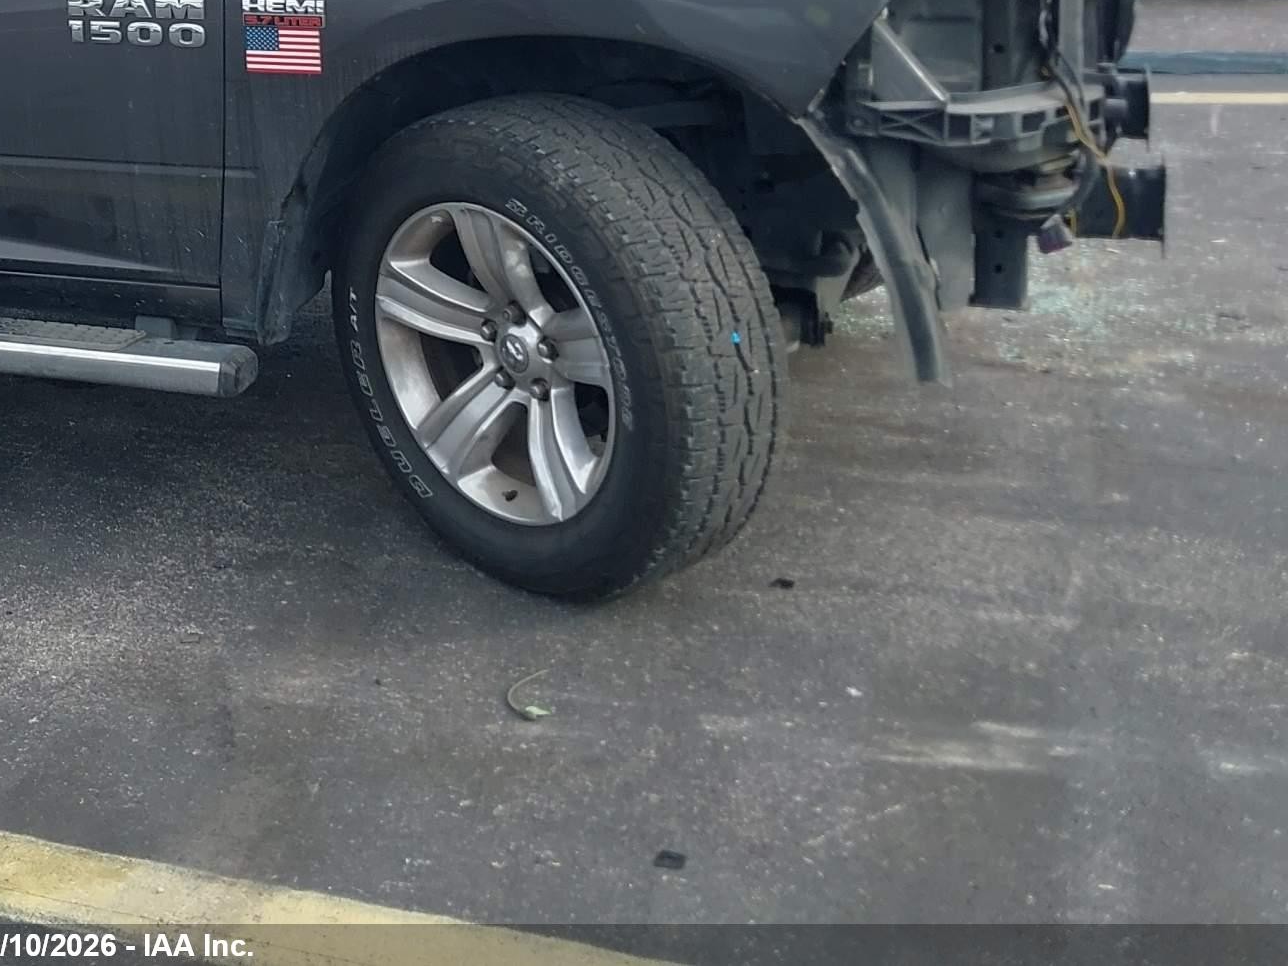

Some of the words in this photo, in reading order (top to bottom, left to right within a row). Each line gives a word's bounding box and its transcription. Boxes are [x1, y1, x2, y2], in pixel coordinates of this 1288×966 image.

[67, 19, 206, 48] 1500
[274, 16, 321, 27] LITER
[350, 341, 432, 497] DUELER
